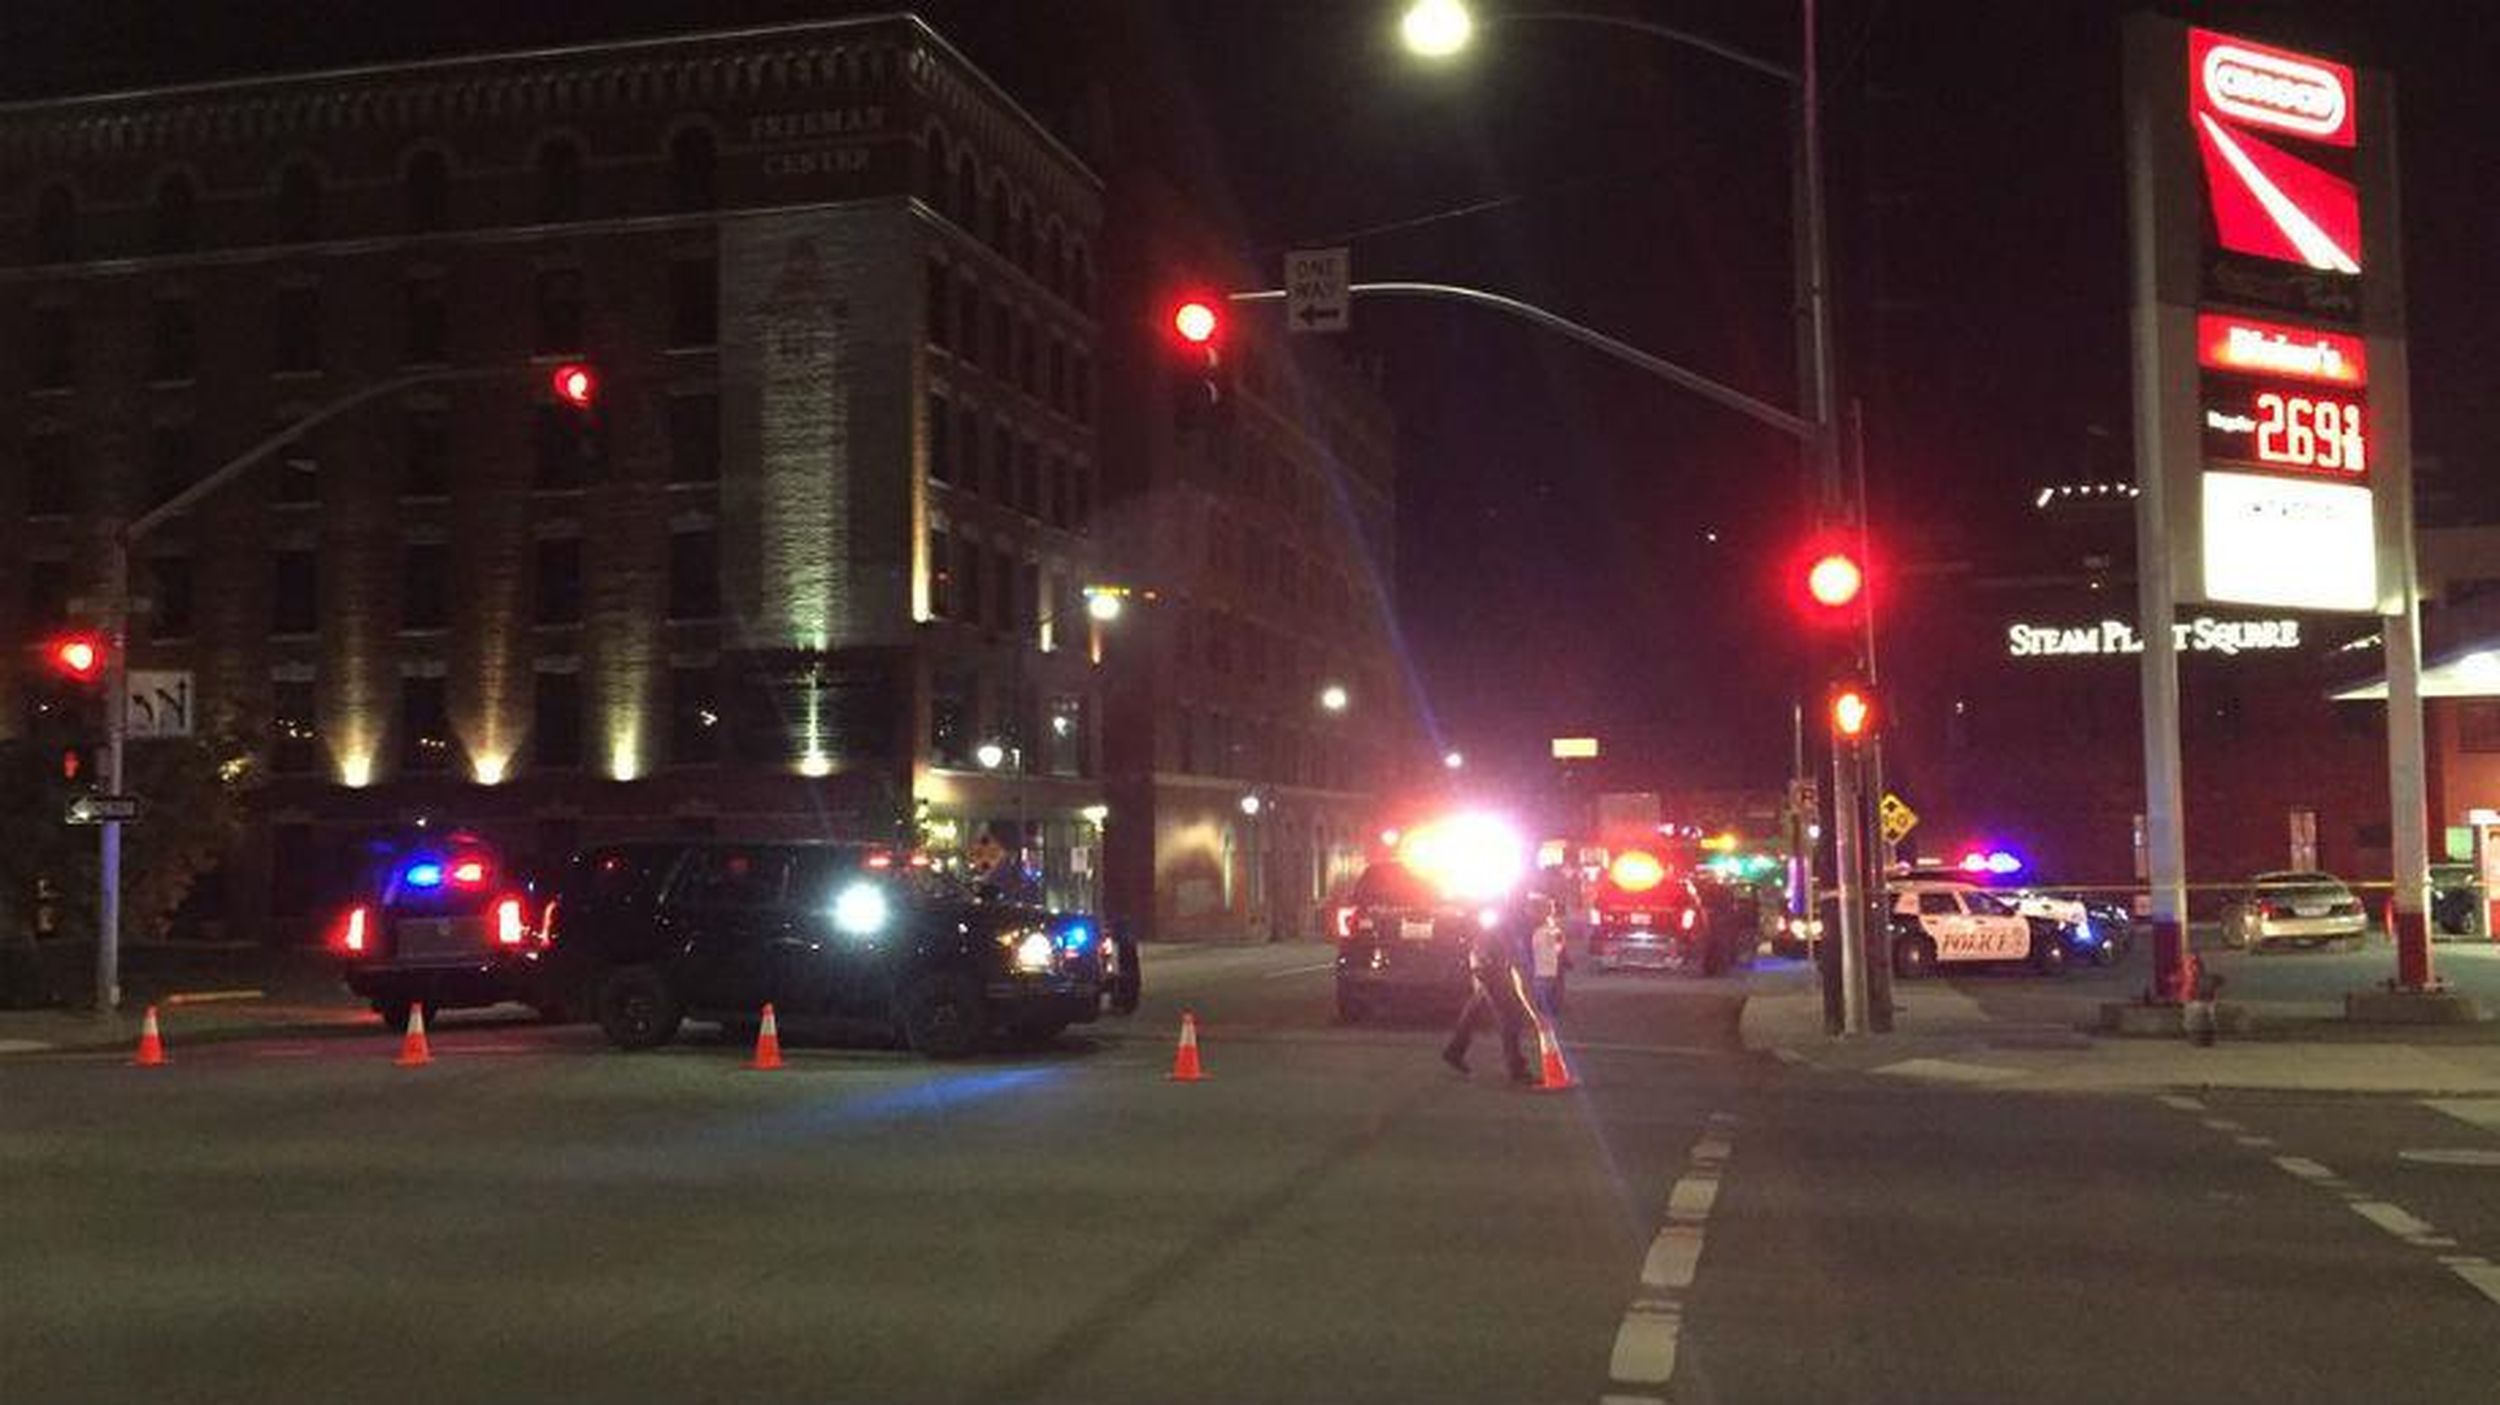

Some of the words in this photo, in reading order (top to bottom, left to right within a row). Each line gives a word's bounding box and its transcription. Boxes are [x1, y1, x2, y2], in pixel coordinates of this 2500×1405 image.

[763, 148, 870, 175] CENTER
[1297, 258, 1337, 279] ONE
[1295, 281, 1337, 299] WAY
[2010, 624, 2099, 655] STEAM
[2193, 618, 2299, 654] SQUARE
[1943, 933, 2007, 953] POLICE
